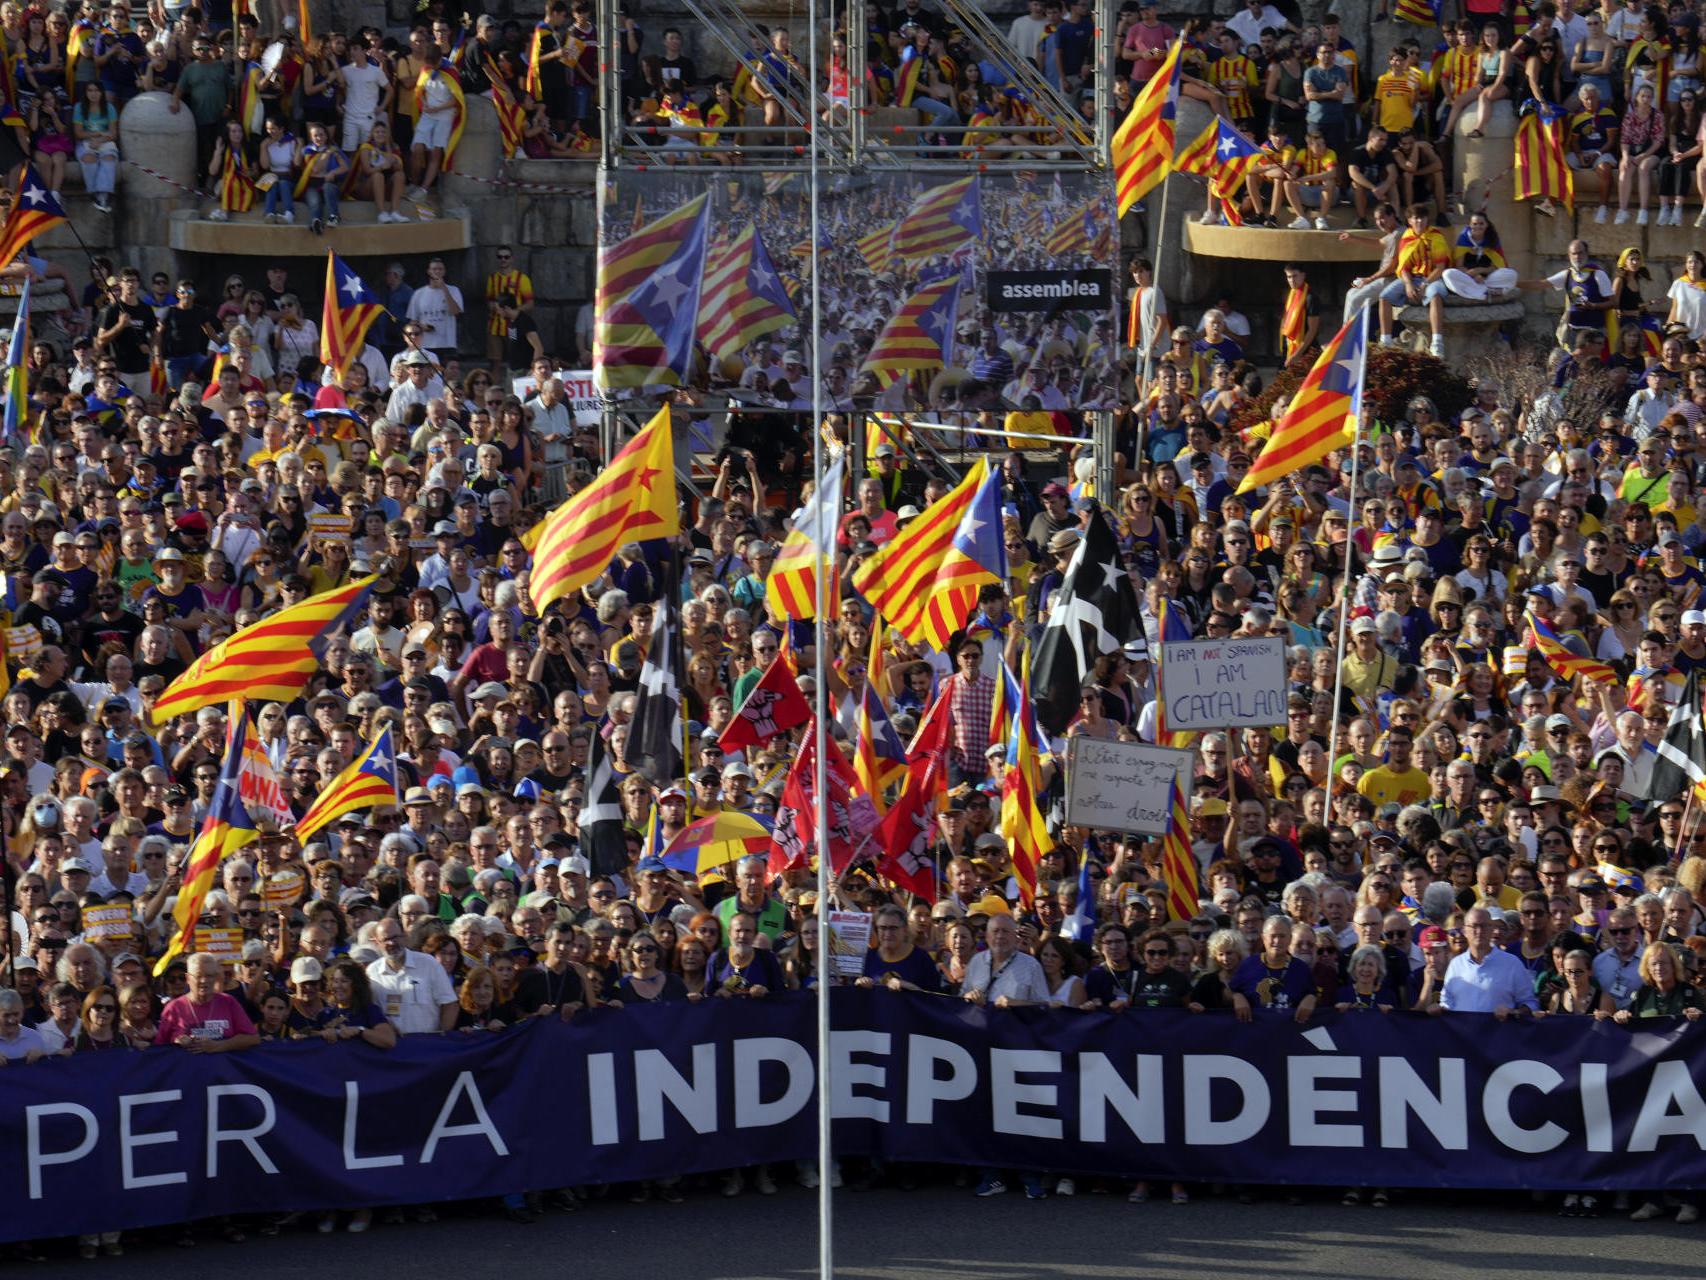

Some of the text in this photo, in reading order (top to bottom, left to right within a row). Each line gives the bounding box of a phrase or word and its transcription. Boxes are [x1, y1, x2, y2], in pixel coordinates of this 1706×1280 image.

[1002, 280, 1100, 297] assemblea
[1177, 648, 1195, 661] AM
[1216, 664, 1246, 683] AM
[1172, 689, 1288, 723] CATALAN
[26, 1026, 1706, 1199] PER LA INDEPENDÈNCIA
